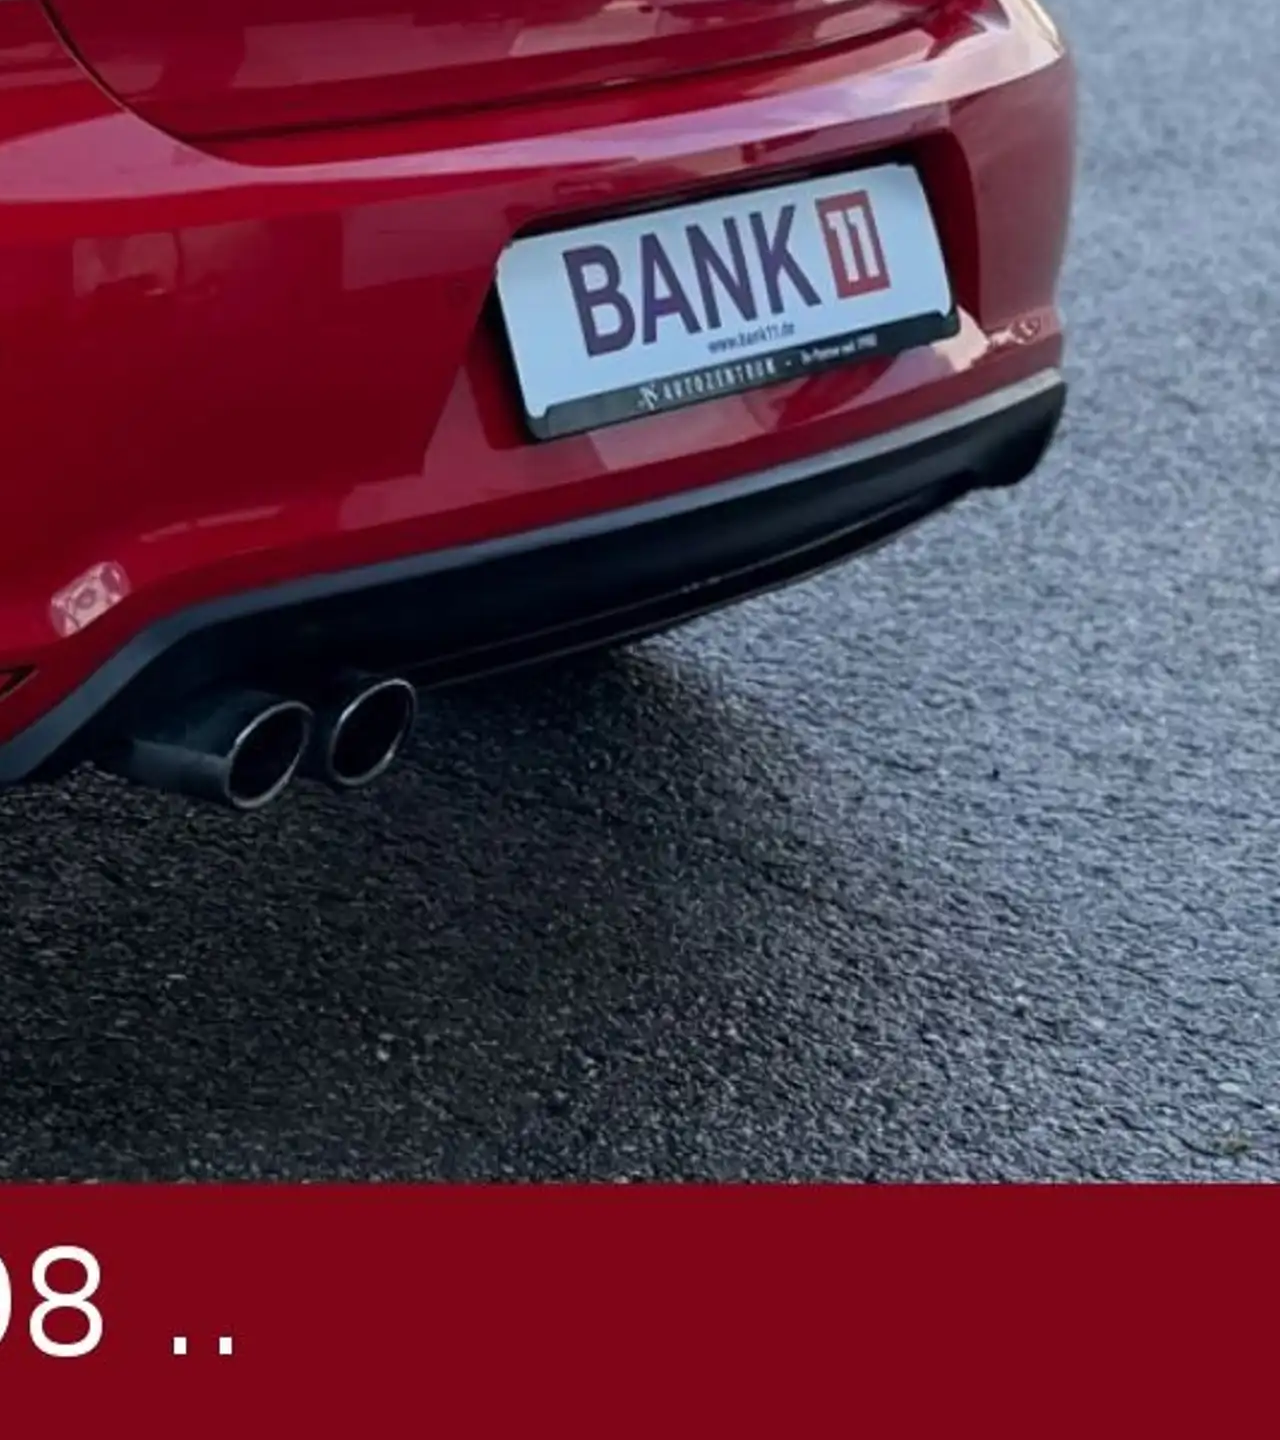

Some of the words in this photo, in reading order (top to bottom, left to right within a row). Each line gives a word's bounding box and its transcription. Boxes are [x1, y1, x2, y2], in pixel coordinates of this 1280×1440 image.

[562, 203, 822, 358] BANK
[823, 204, 882, 286] 11
[707, 321, 796, 355] www.bank11.de
